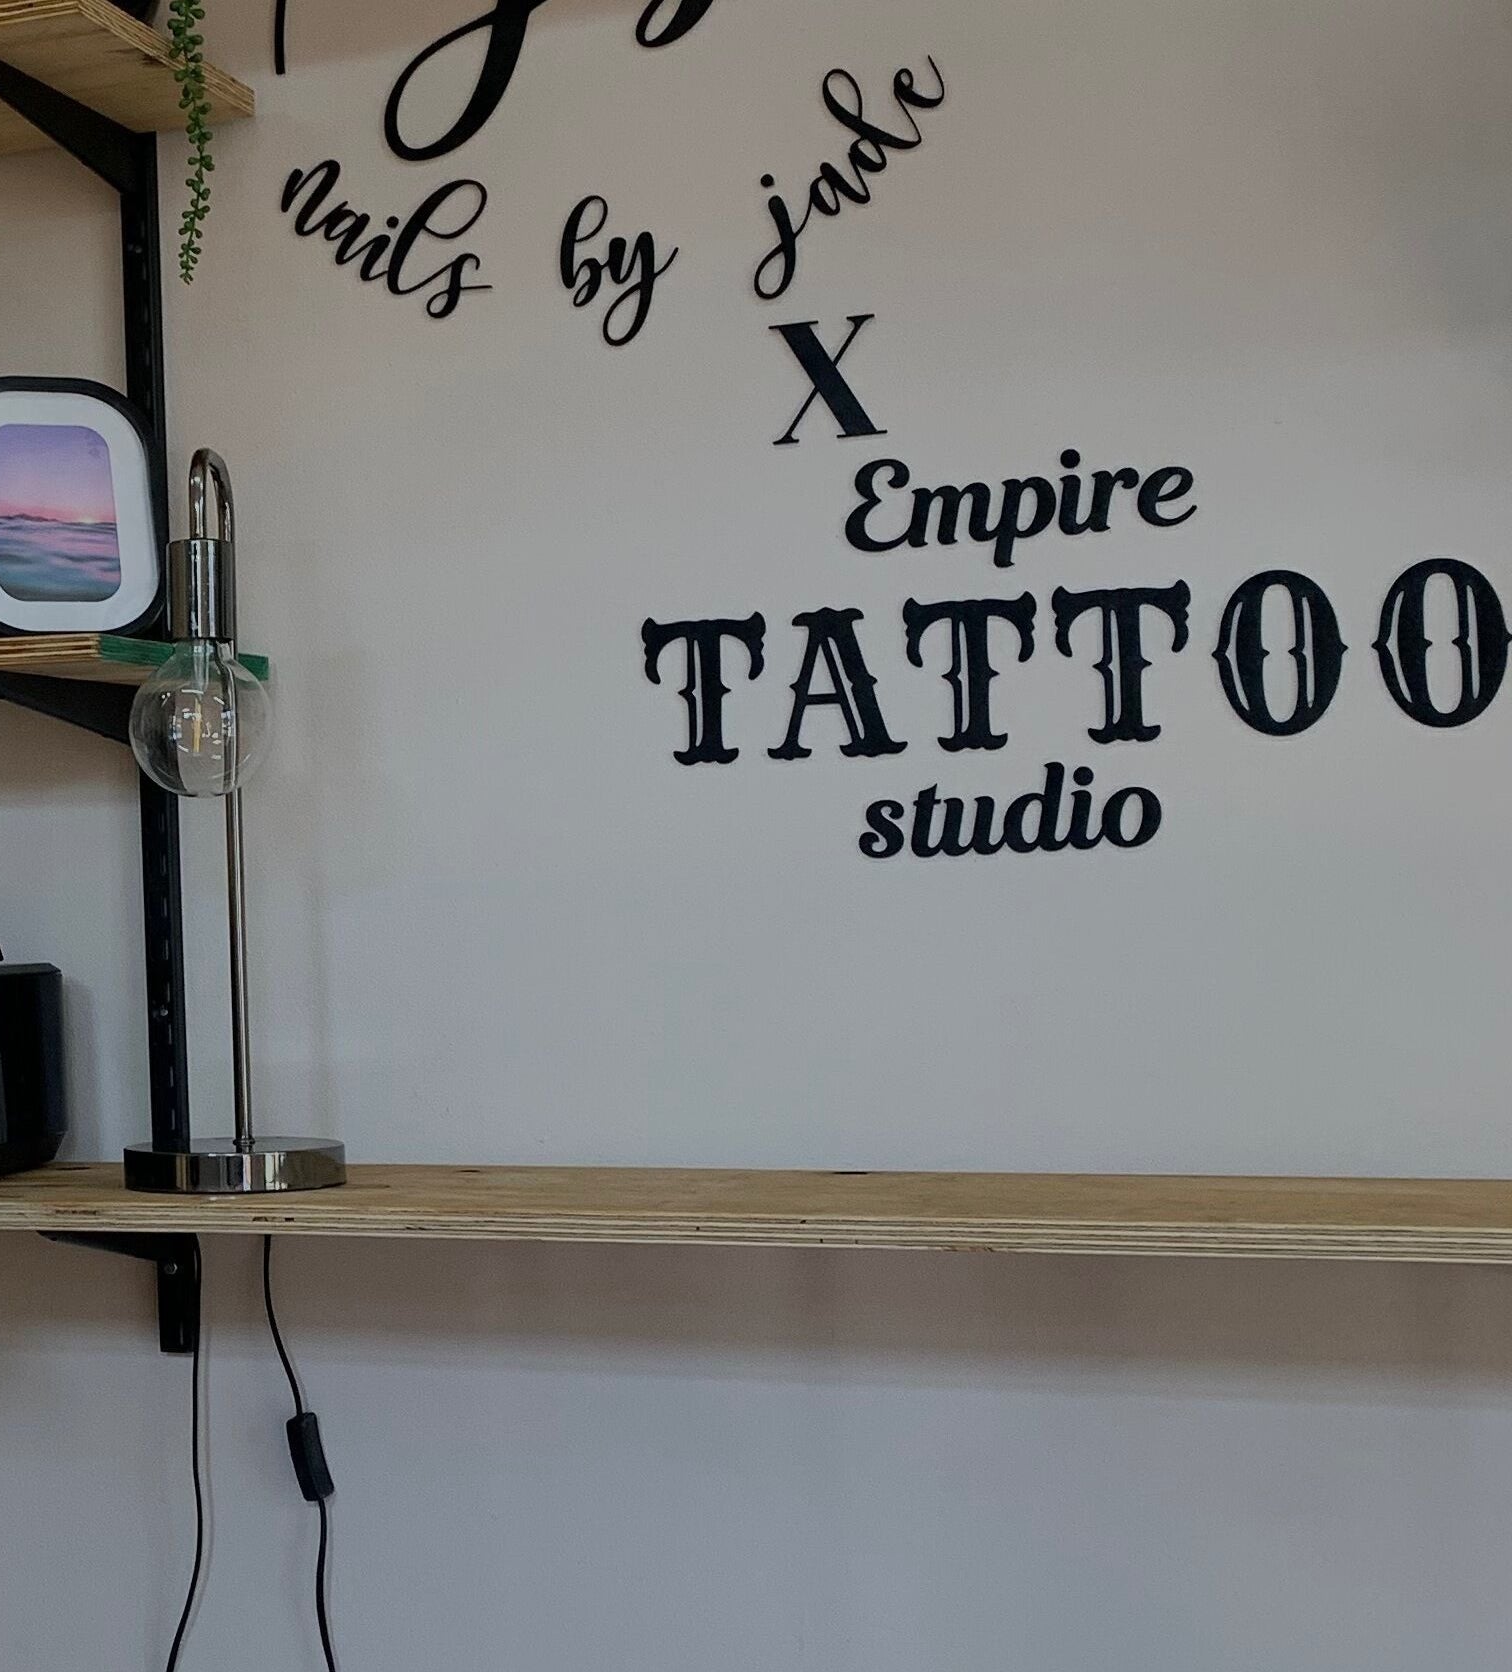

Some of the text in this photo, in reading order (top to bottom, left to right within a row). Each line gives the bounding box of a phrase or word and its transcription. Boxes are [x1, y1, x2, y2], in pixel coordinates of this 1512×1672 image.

[280, 158, 493, 320] nails
[559, 195, 678, 347] by
[753, 53, 948, 300] jade
[769, 313, 888, 446] X
[845, 448, 1199, 568] Empire
[641, 557, 1512, 766] TATTOO
[858, 761, 1163, 858] studio
